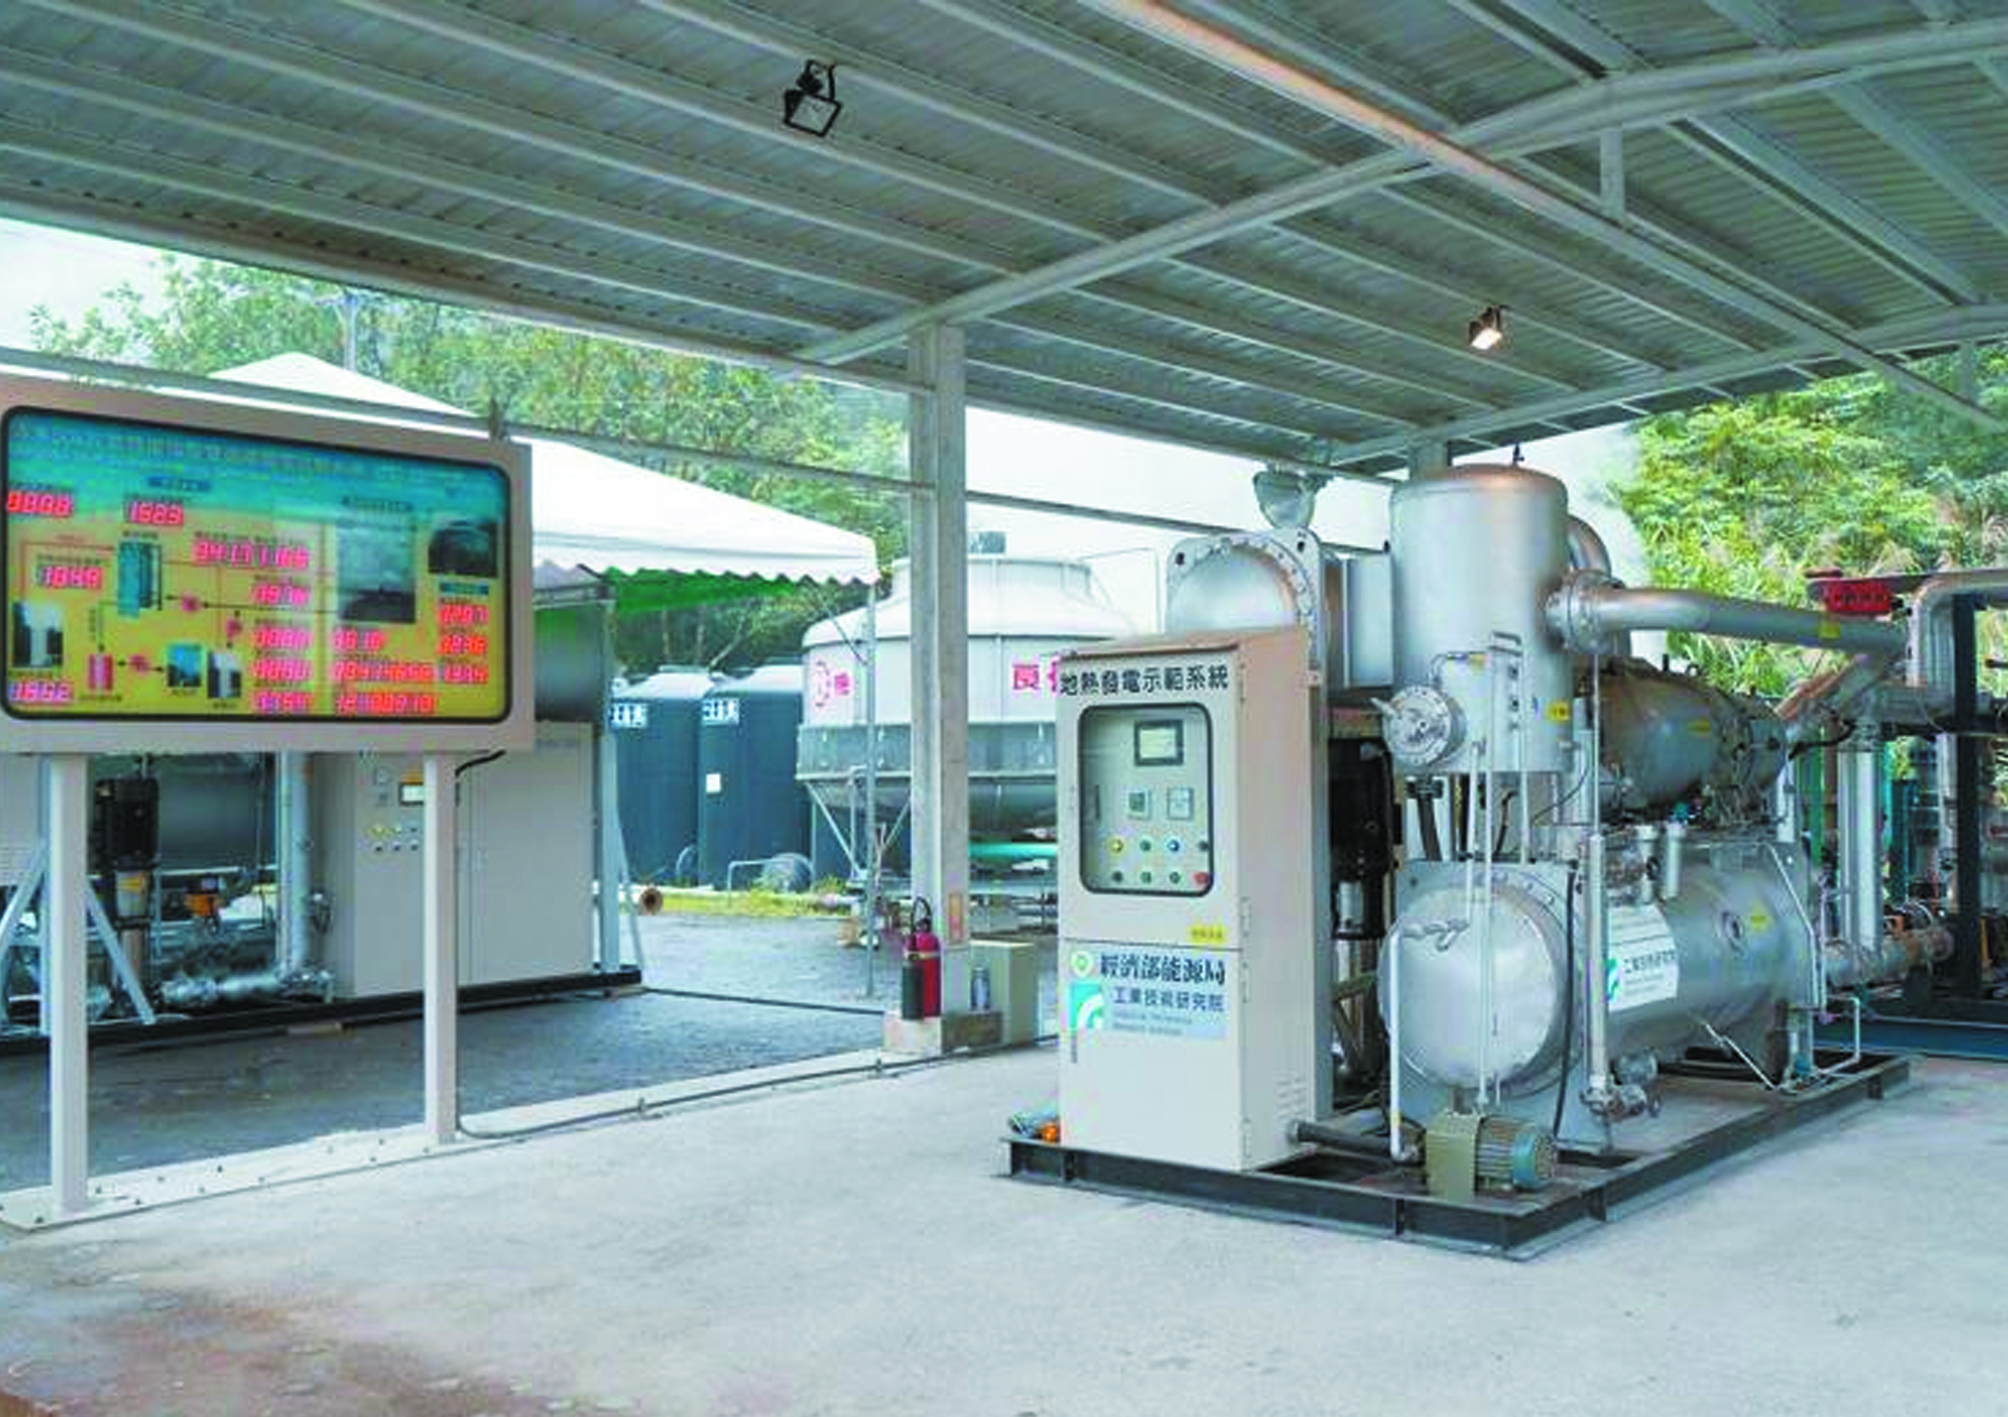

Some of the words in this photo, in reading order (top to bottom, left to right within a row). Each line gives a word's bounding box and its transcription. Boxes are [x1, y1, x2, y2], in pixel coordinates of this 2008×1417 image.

[1059, 664, 1229, 696] 地熱發電示範系統
